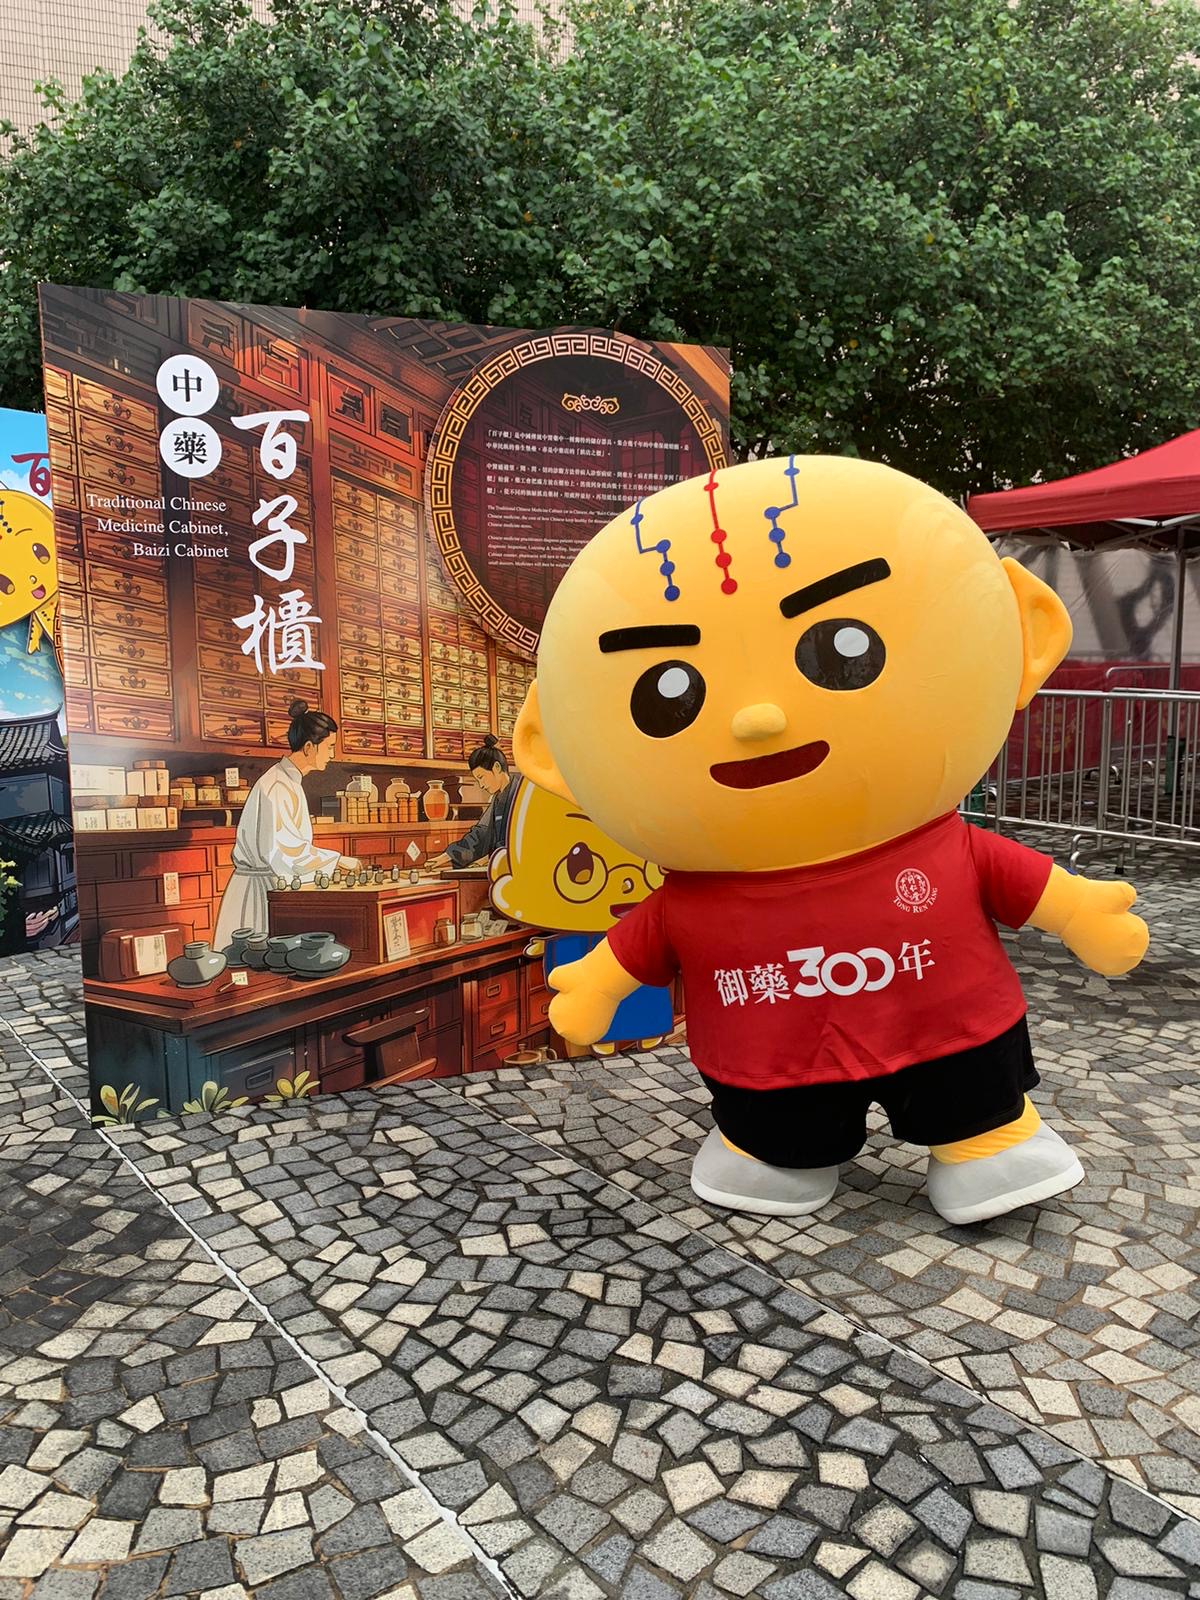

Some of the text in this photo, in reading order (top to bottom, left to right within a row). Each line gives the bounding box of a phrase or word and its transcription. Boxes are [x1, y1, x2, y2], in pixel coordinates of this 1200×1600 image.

[172, 368, 208, 466] 中藥
[86, 493, 226, 512] Traditional Chinese
[97, 518, 230, 536] Medicine Cabinet,
[231, 409, 326, 675] 百子櫃
[133, 542, 230, 558] Baizi Cabinet
[714, 938, 936, 1007] 御藥300年
